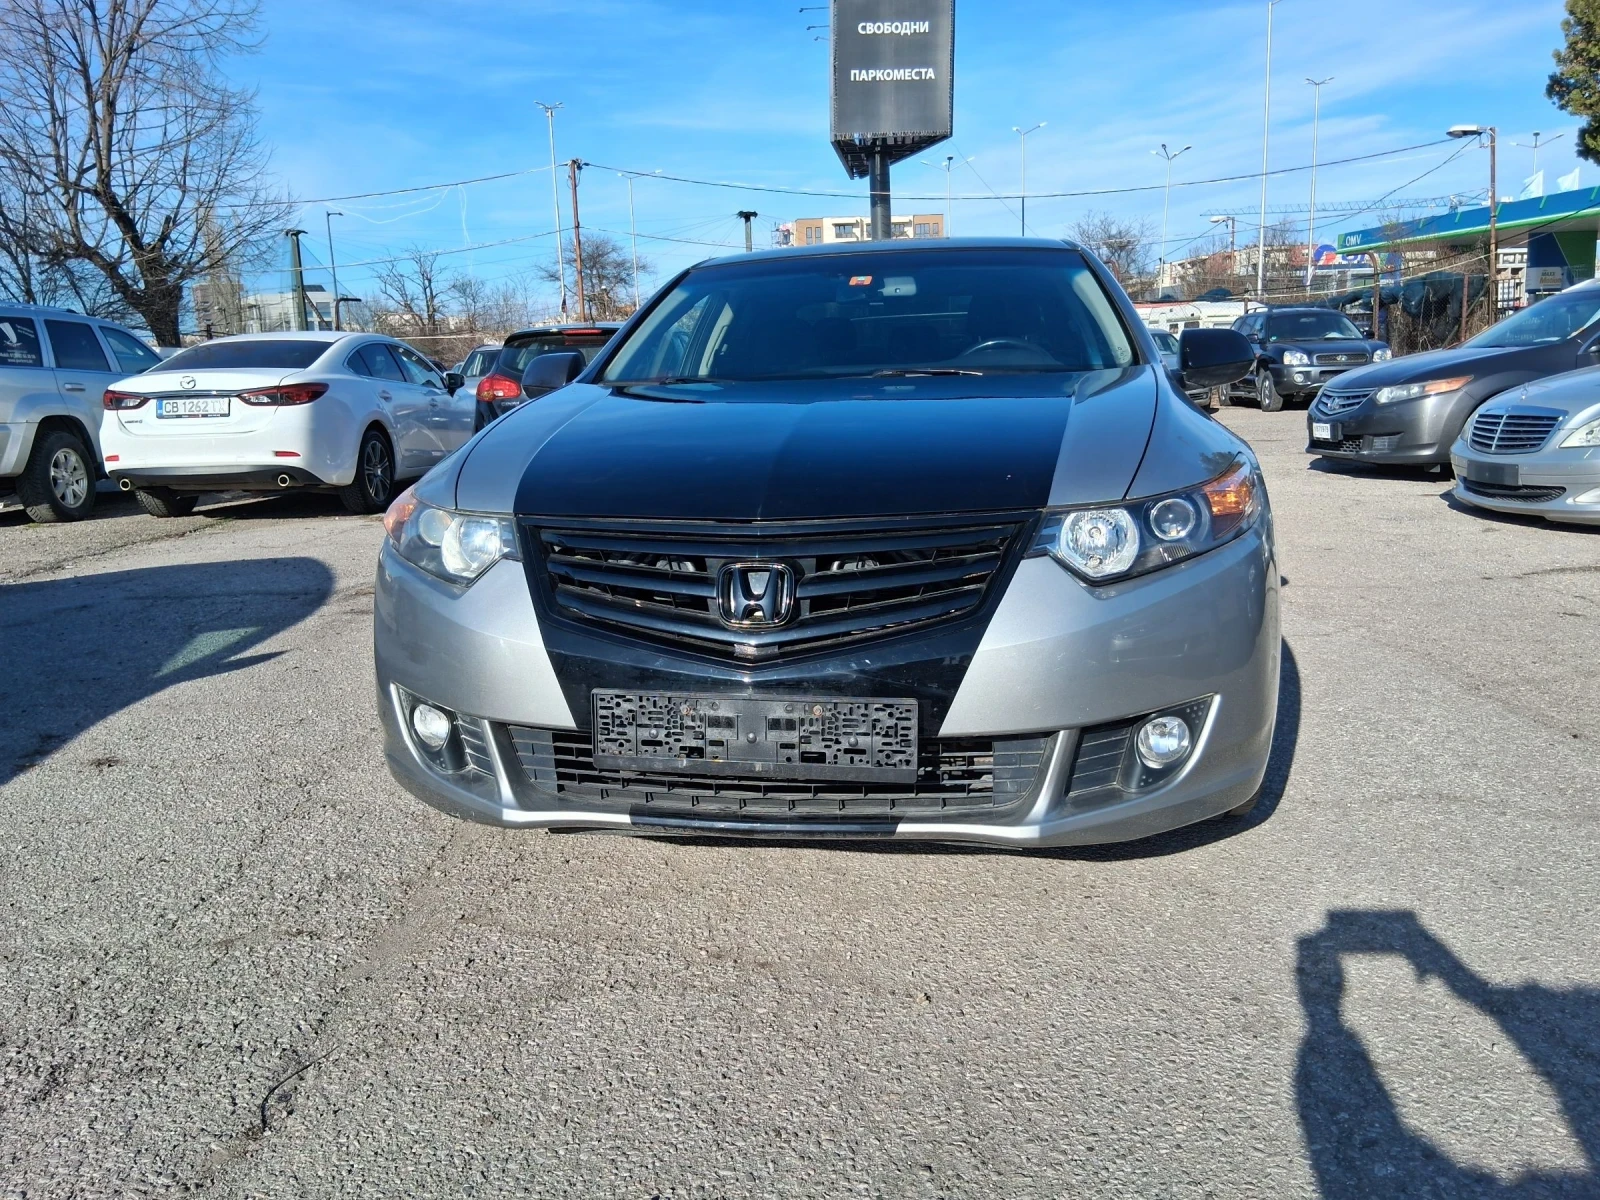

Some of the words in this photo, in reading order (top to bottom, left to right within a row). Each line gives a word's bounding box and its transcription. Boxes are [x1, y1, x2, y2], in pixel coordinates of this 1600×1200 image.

[857, 21, 929, 35] СВОБОДНИ
[850, 67, 935, 81] ПАРКОМЕСТА
[1345, 233, 1362, 247] OMV
[182, 400, 209, 413] 1262
